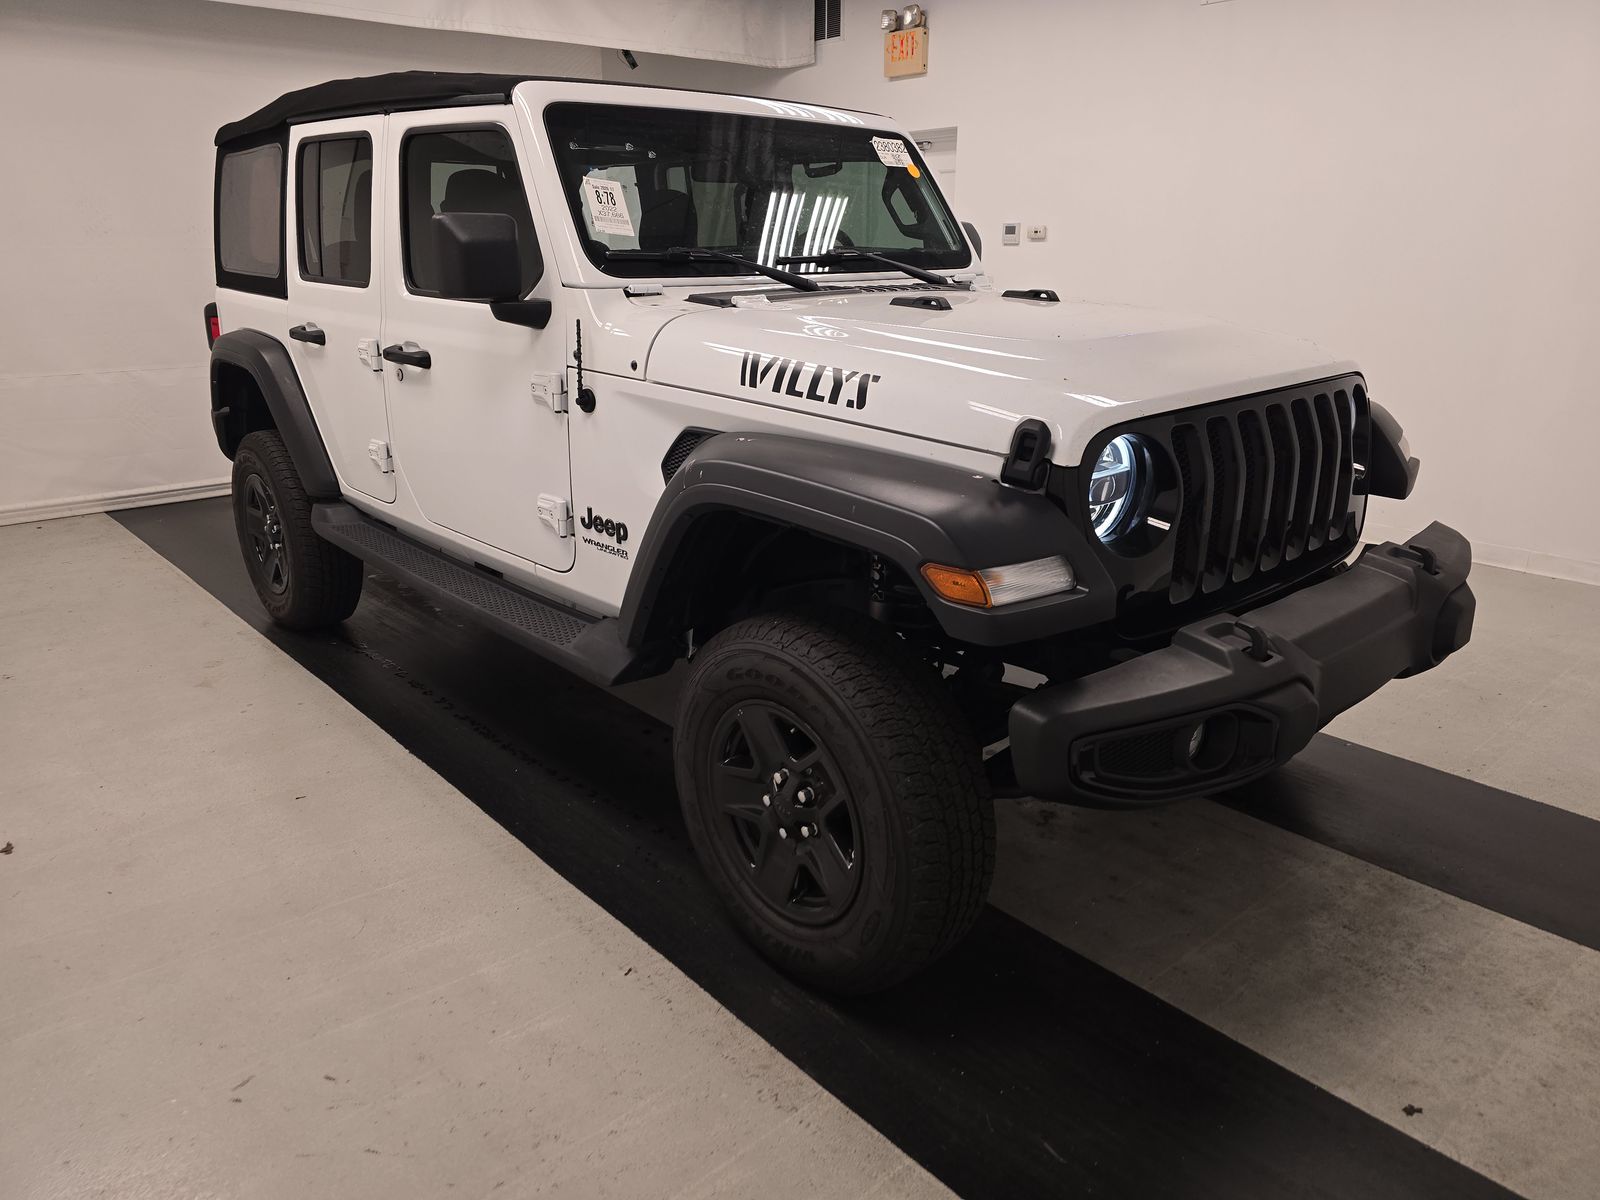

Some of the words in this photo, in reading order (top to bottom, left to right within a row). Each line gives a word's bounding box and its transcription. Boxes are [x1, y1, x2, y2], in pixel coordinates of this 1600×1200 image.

[891, 31, 917, 62] EXIT
[595, 189, 616, 206] 8:78
[740, 351, 881, 410] WILLYS
[580, 506, 629, 545] Jeep
[582, 536, 629, 557] WRANGLER
